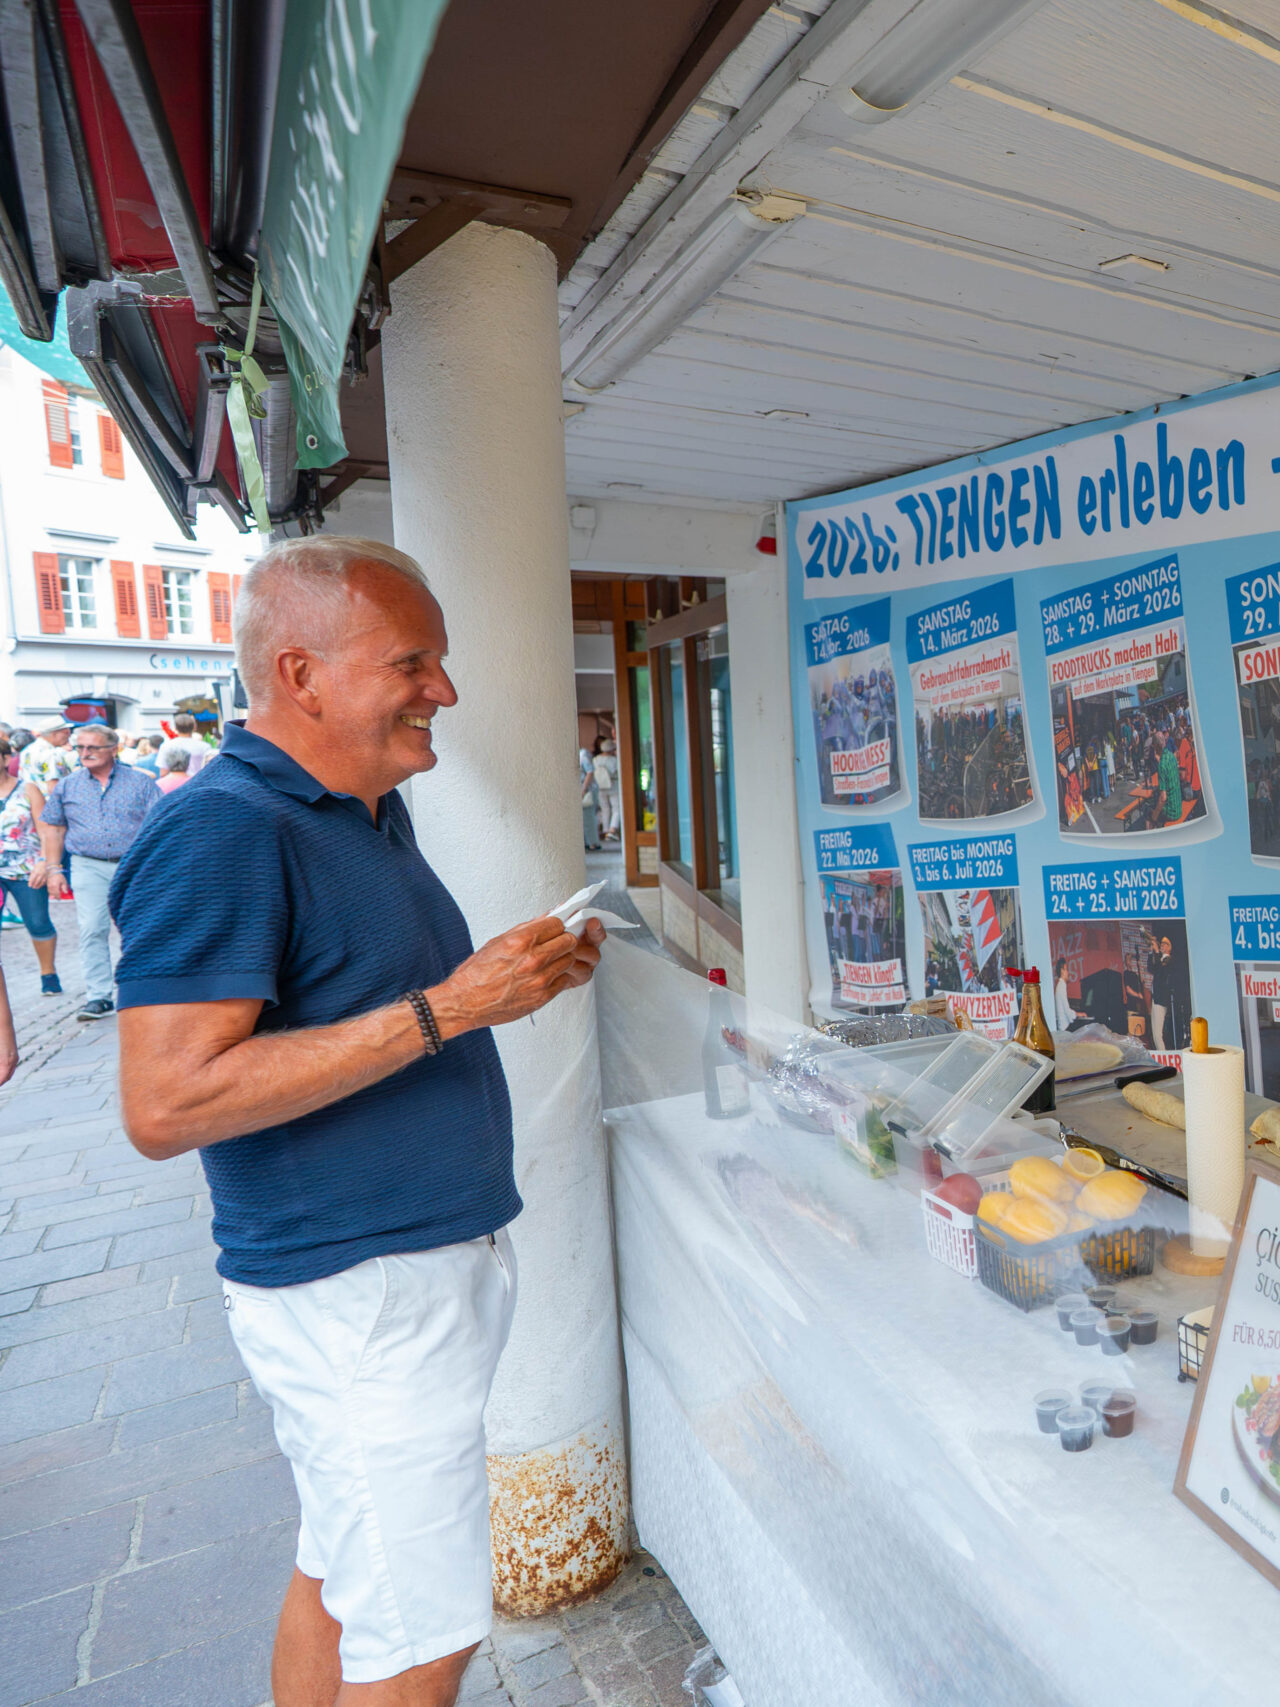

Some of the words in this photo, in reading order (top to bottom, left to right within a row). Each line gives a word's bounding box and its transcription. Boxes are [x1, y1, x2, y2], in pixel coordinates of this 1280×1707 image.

[805, 512, 899, 579] 2026:
[896, 456, 1061, 566] TIENGEN
[1077, 422, 1245, 537] erleben
[1042, 592, 1092, 625] SAMSTAG
[1114, 563, 1179, 600] SONNTAG
[918, 600, 972, 635] SAMSTAG
[1045, 625, 1063, 646] 28.
[1078, 612, 1100, 635] 29.
[1103, 602, 1140, 627] März
[1143, 585, 1181, 615] 2026
[1243, 607, 1272, 635] 29.
[847, 627, 870, 651] 2026
[921, 634, 939, 655] 14.
[941, 628, 968, 650] März
[970, 612, 1000, 639] 2026
[1052, 647, 1112, 682] FOODTRUCKS
[1114, 639, 1152, 665] machen
[1155, 629, 1179, 655] Halt
[820, 831, 852, 850] FREITAG
[912, 845, 949, 863] FREITAG
[950, 844, 965, 861] bis
[967, 839, 1013, 859] MONTAG
[821, 852, 835, 867] 22.
[836, 848, 850, 867] Mai
[851, 849, 879, 866] 2026
[915, 866, 925, 881] 3.
[926, 864, 940, 881] bis
[942, 864, 952, 880] 6.
[955, 861, 973, 879] Juli
[976, 860, 1003, 878] 2026
[1050, 872, 1097, 891] FREITAG
[1113, 867, 1176, 888] SAMSTAG
[1051, 895, 1071, 913] 24.
[1089, 893, 1111, 912] 25.
[1114, 891, 1138, 912] Juli
[1141, 889, 1178, 911] 2026
[1235, 925, 1252, 949] 4.
[1232, 1322, 1255, 1345] FÜR
